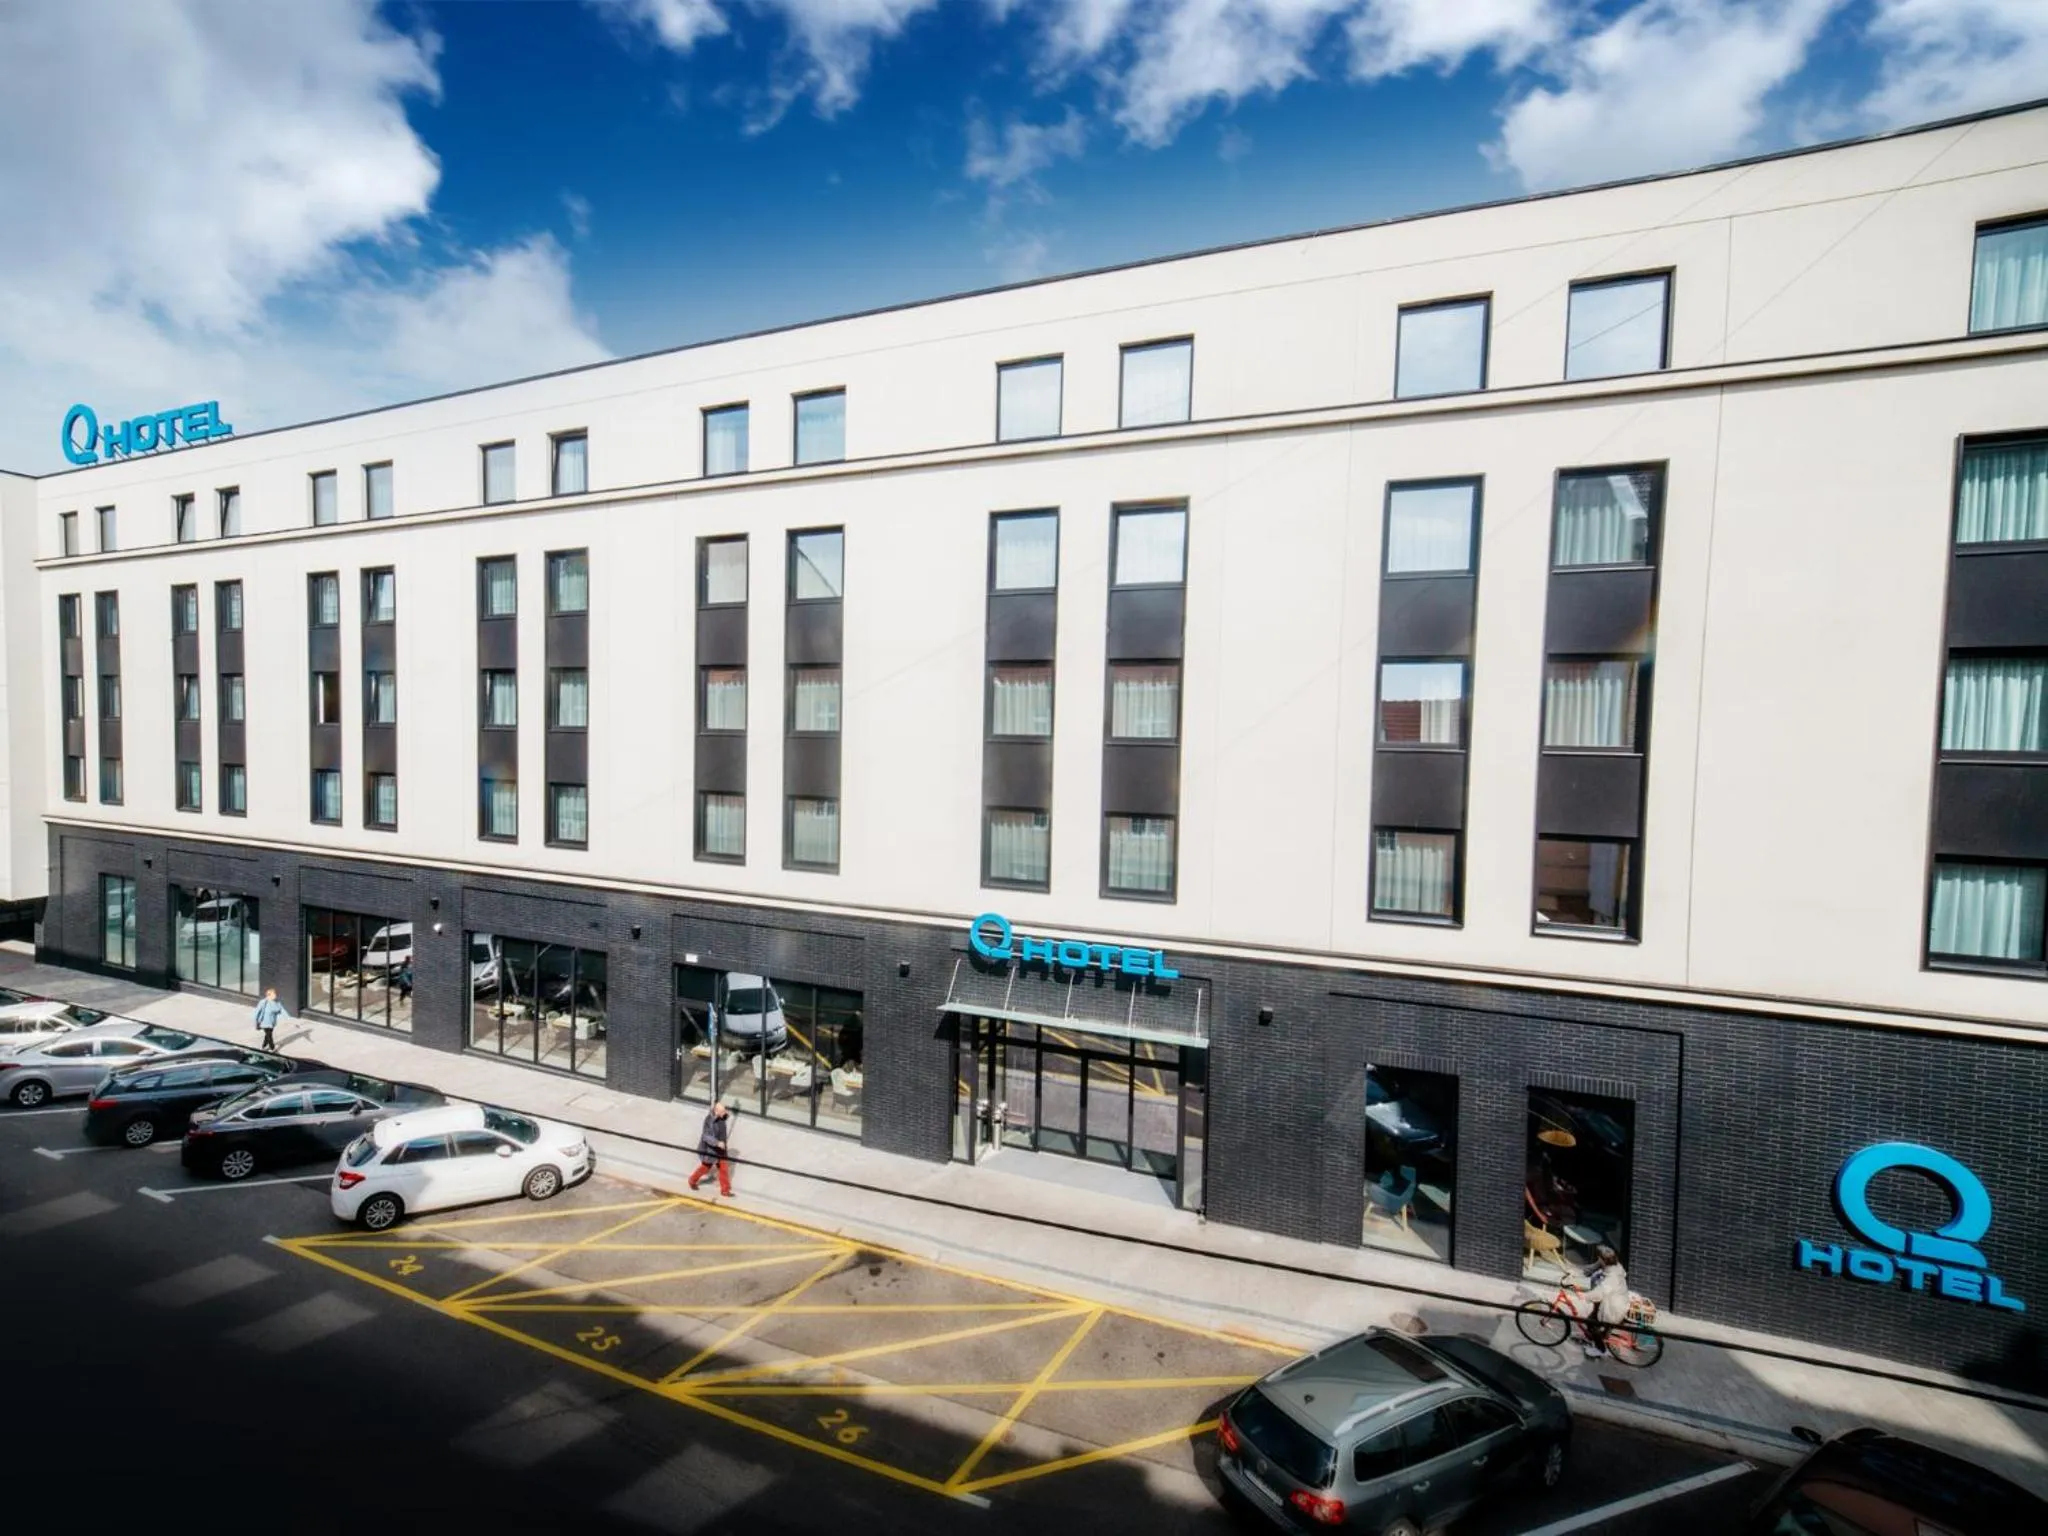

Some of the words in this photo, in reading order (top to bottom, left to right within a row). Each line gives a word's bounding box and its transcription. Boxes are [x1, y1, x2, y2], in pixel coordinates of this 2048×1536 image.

[103, 401, 233, 458] HOTEL
[1022, 936, 1179, 979] HOTEL
[389, 1254, 425, 1276] 24
[1797, 1238, 2026, 1312] HOTEL
[575, 1326, 621, 1351] 25
[817, 1408, 869, 1444] 26
